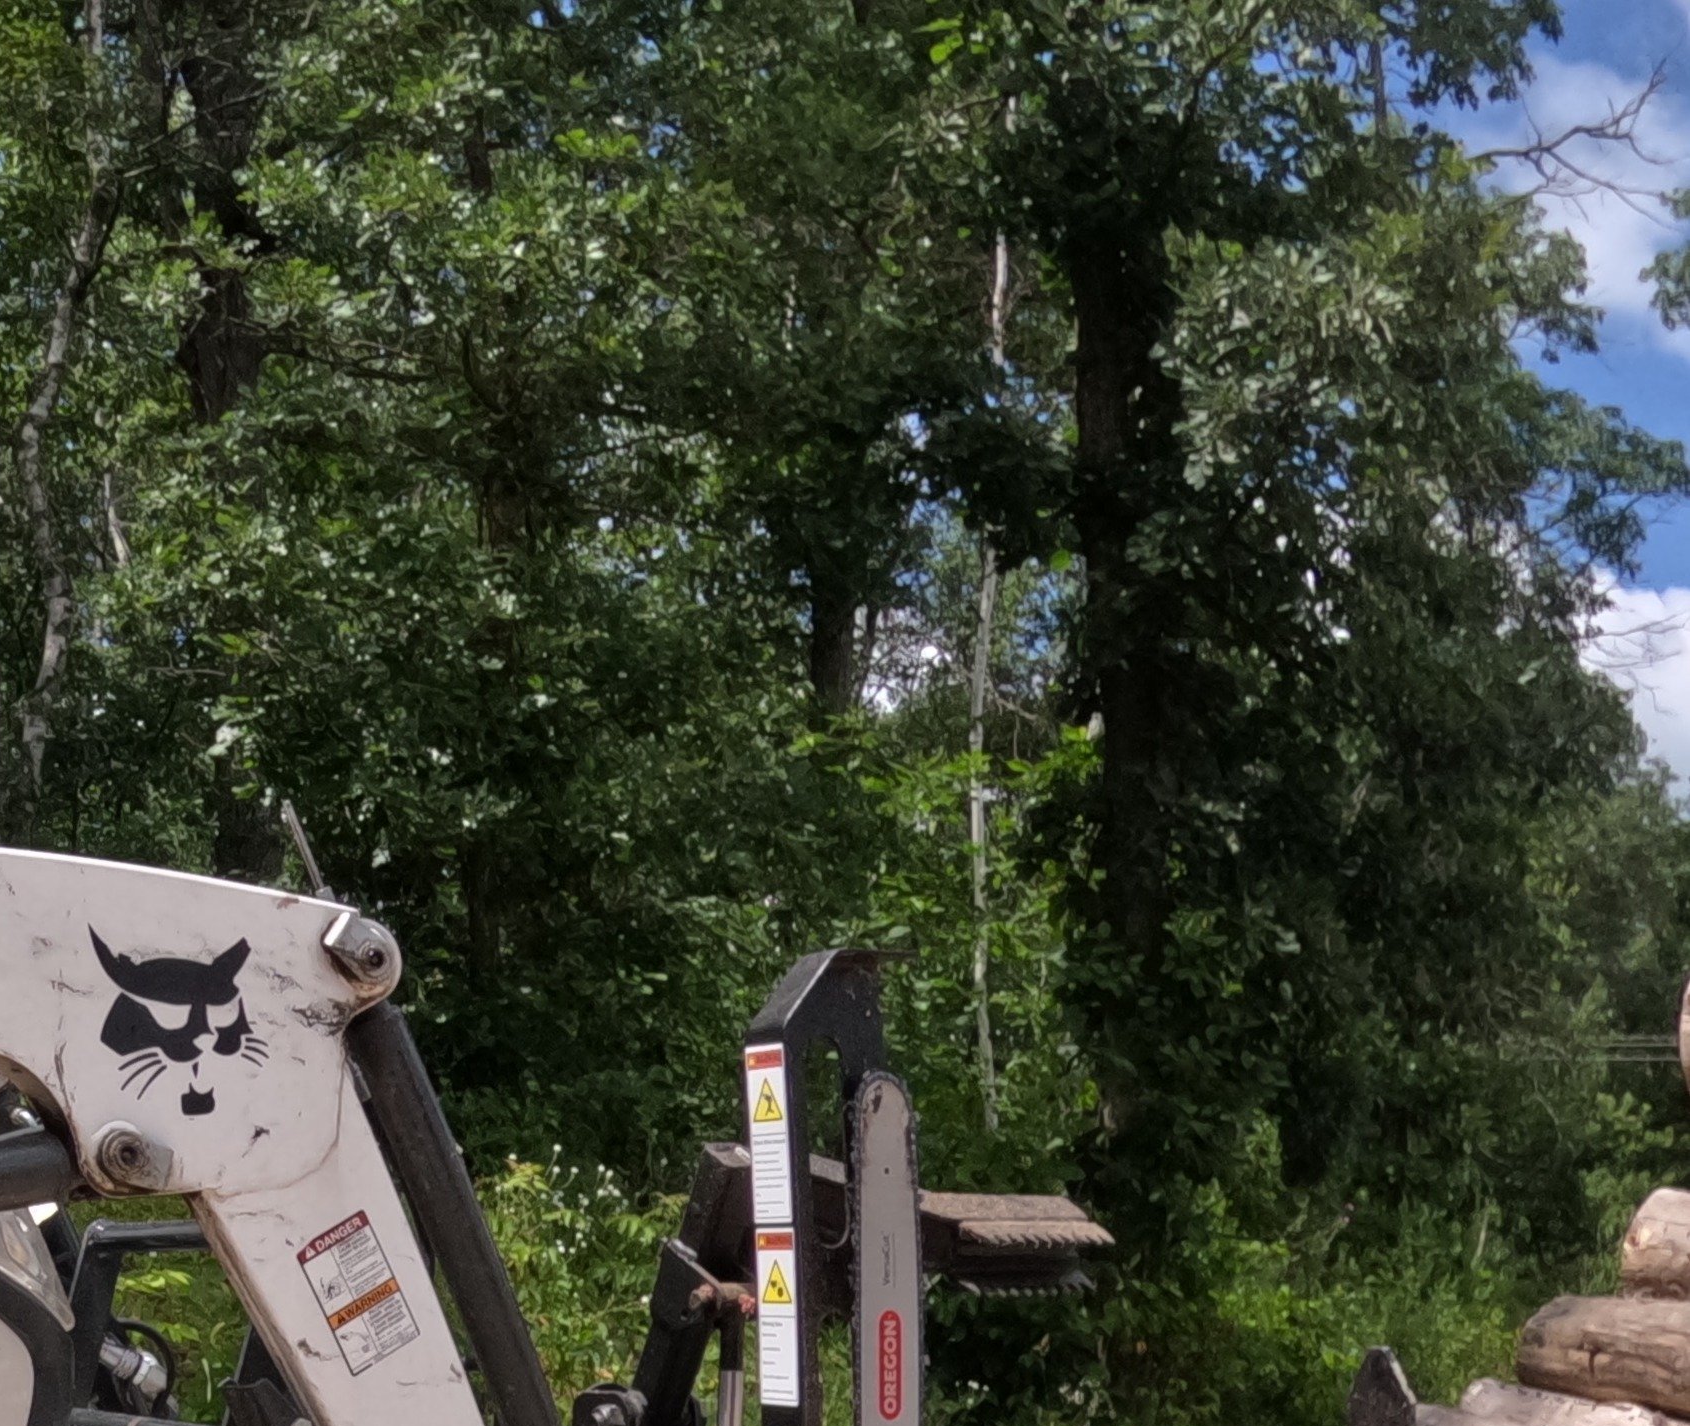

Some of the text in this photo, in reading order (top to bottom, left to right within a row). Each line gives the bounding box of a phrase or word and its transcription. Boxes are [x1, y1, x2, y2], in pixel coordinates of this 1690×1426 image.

[315, 1217, 363, 1251] DANGER
[345, 1284, 393, 1317] WARNING
[883, 1319, 897, 1415] OREGON
